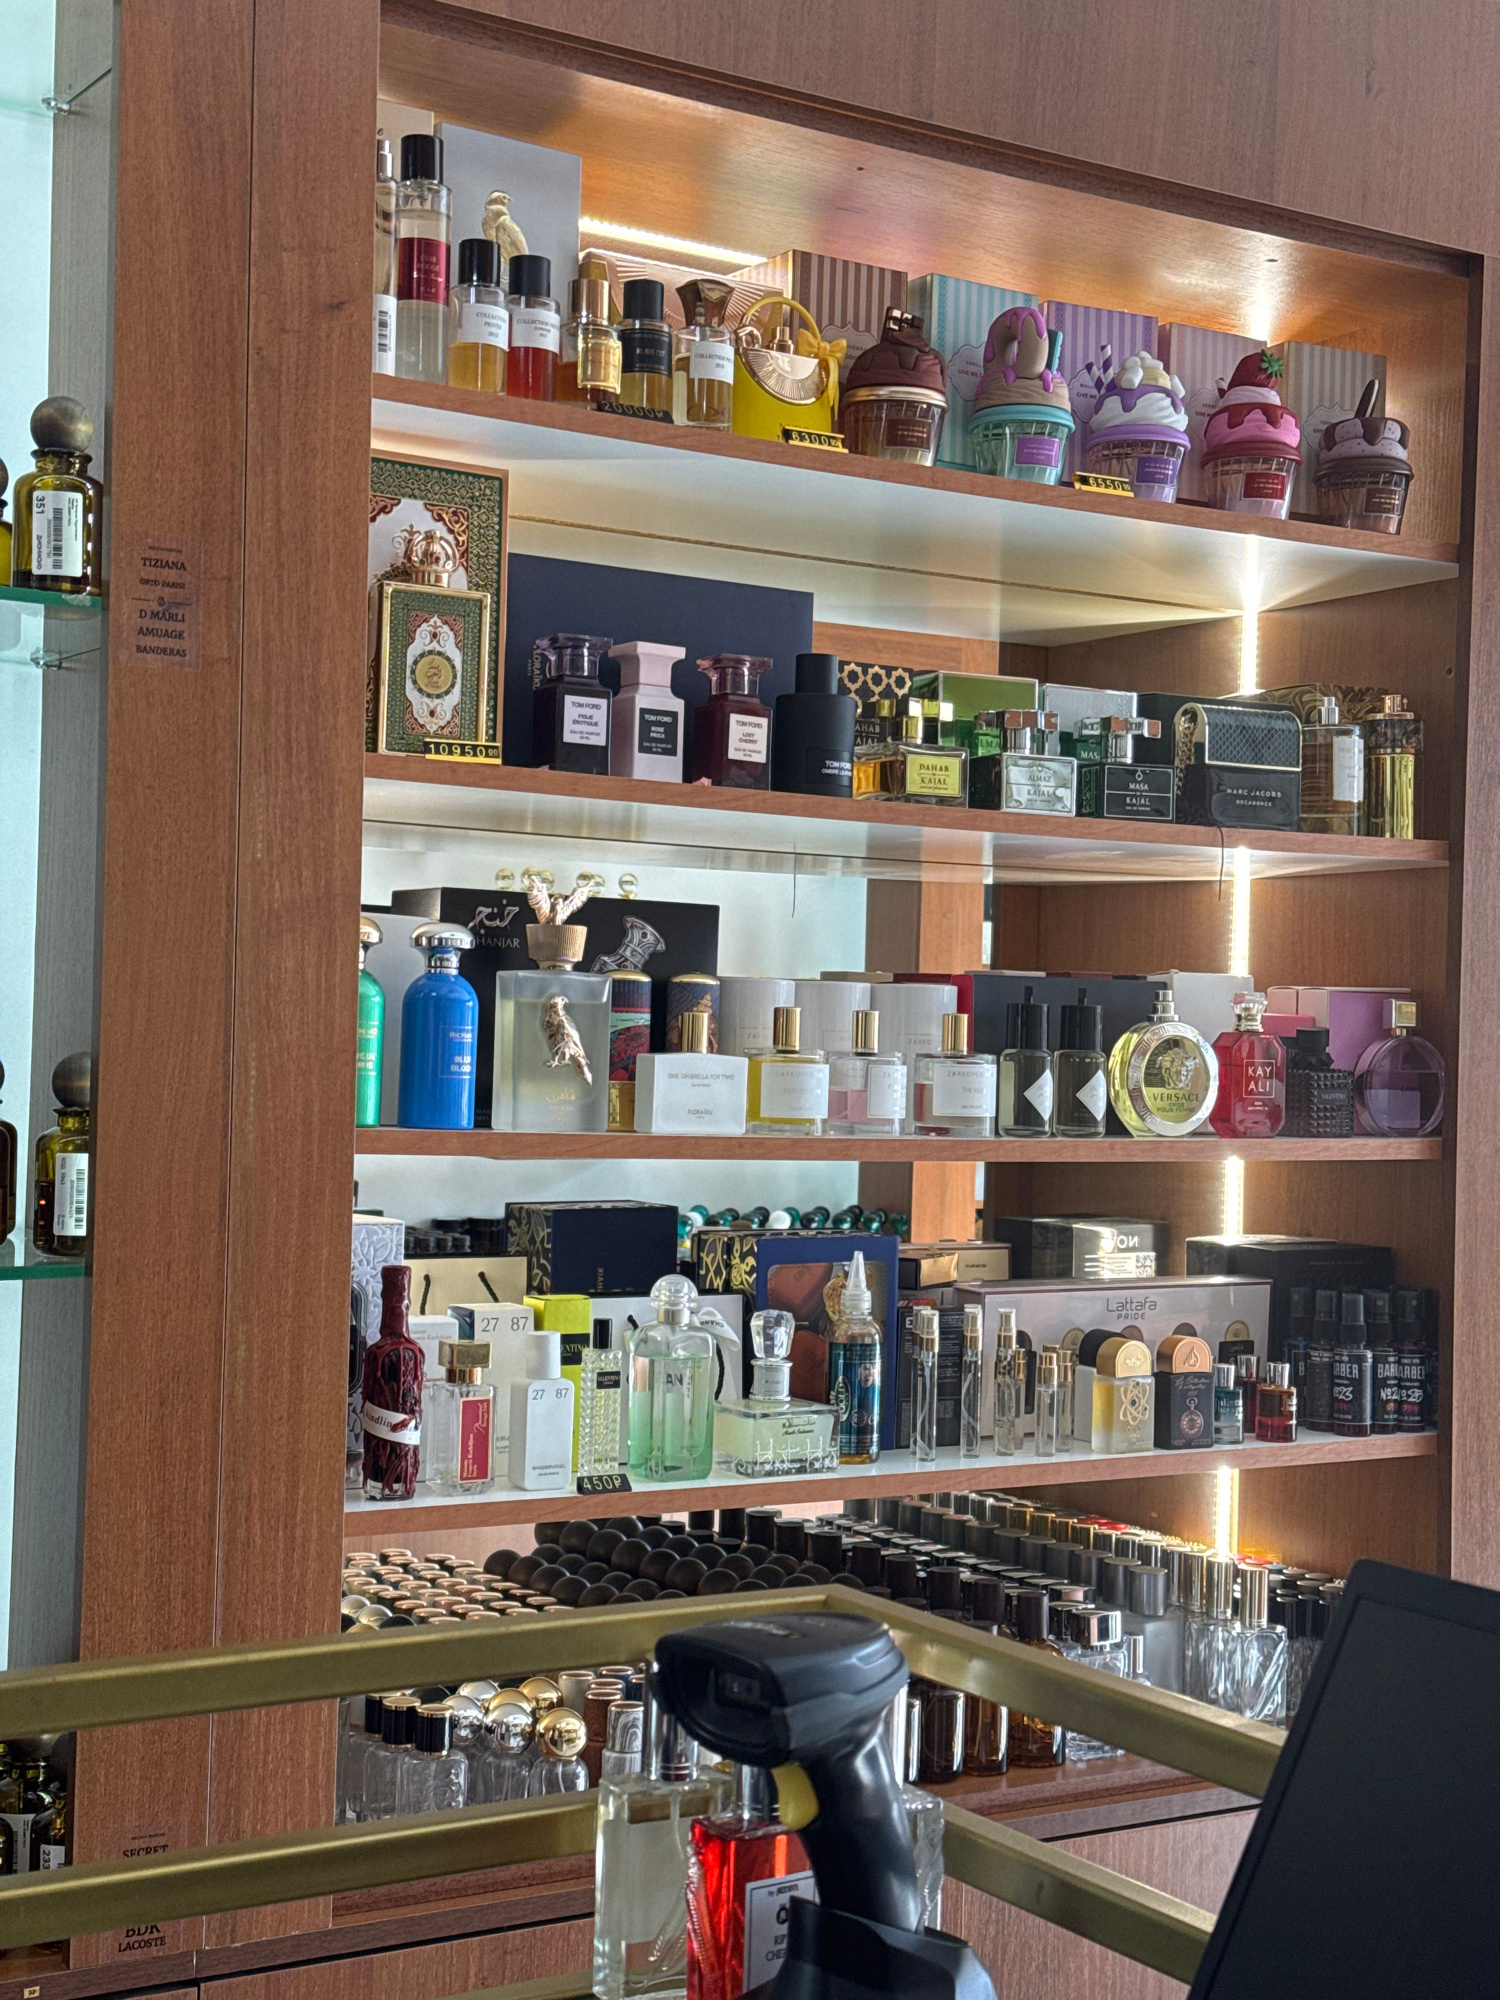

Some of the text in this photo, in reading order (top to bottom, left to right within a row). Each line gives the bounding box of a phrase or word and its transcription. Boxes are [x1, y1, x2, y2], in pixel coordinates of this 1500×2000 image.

[791, 430, 830, 447] 6300
[1088, 476, 1123, 492] 6550
[35, 495, 46, 515] 351
[140, 556, 187, 572] TIZIANA
[149, 609, 185, 623] MARLI
[136, 626, 185, 641] AMUAGE
[135, 644, 188, 659] BANDERAS
[571, 701, 602, 711] TOM FORD
[644, 714, 673, 723] TOM FORD
[736, 720, 763, 729] TOM FORD
[855, 723, 880, 734] AHAB
[855, 737, 879, 747] AJAL
[428, 742, 486, 759] 10950
[1080, 750, 1100, 760] MAS
[824, 760, 840, 768] TOM
[919, 763, 950, 773] DAHAB
[920, 777, 949, 786] KAJAL
[1028, 775, 1052, 783] ALMAZ
[1128, 782, 1149, 791] MASA
[1027, 789, 1051, 797] KAJAL
[1226, 788, 1282, 798] MARC JACOBS
[1126, 797, 1151, 806] KAJAL
[1235, 799, 1272, 807] DECADENCE
[475, 936, 520, 949] HANJAR
[1248, 1065, 1272, 1078] KAY
[1248, 1080, 1270, 1092] ALI
[1152, 1092, 1201, 1102] VERSACE
[1106, 1297, 1157, 1312] Lattafa
[480, 1316, 529, 1333] 27 87
[532, 1388, 569, 1400] 27 87
[583, 1475, 622, 1491] 450₽
[117, 1936, 167, 1952] LACOSTE
